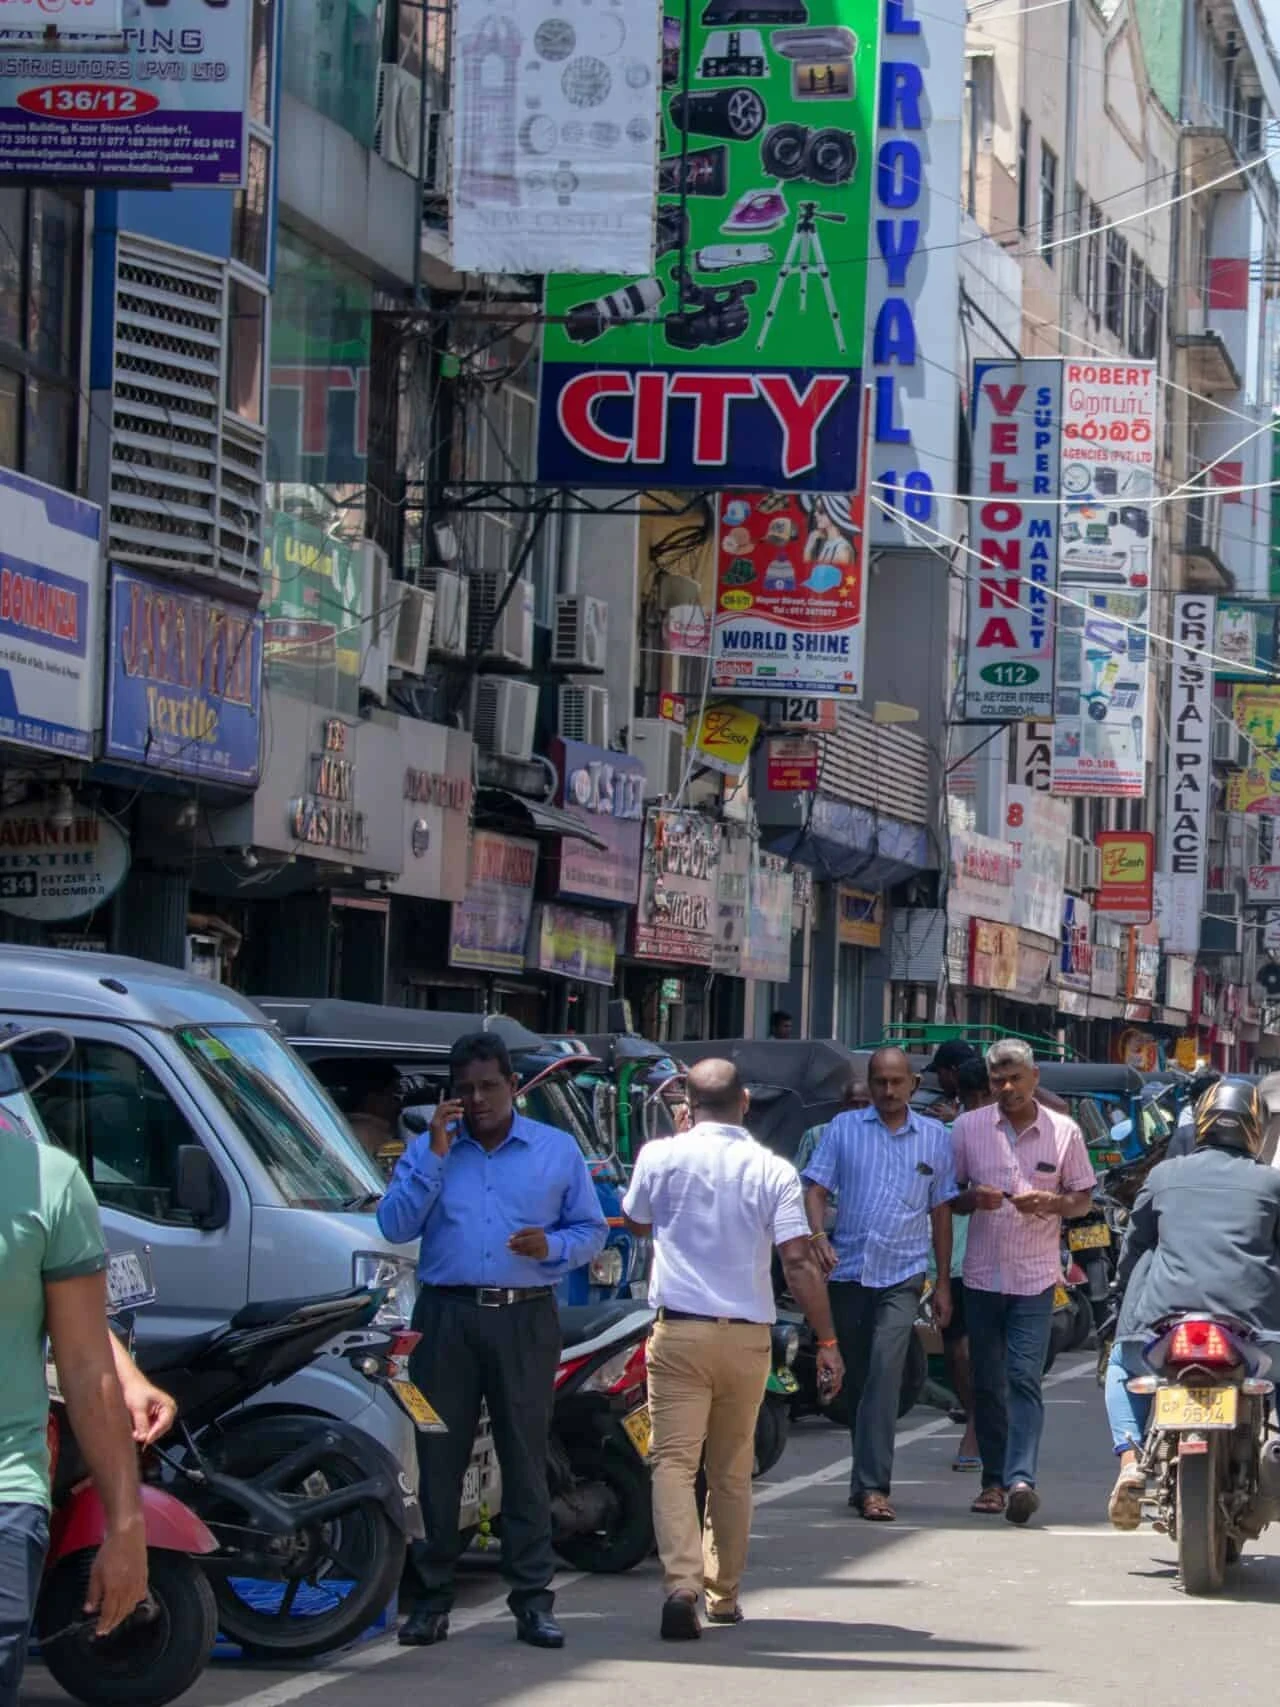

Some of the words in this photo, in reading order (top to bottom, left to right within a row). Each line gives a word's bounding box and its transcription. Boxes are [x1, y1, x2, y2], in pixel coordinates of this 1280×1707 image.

[40, 90, 137, 111] 136/12
[191, 62, 227, 81] LTD
[873, 61, 924, 445] ROYAL
[1068, 366, 1153, 386] ROBERT
[557, 370, 851, 480] CITY
[1033, 387, 1052, 494] SUPER
[976, 384, 1028, 648] VELONNA
[1028, 519, 1053, 649] MARKET
[722, 630, 787, 651] WORLD
[792, 632, 850, 655] SHINE
[994, 667, 1028, 685] 112
[1175, 602, 1207, 743] CRYSTAL
[147, 686, 219, 744] Textile
[781, 699, 820, 722] 124
[1171, 753, 1202, 874] PALACE
